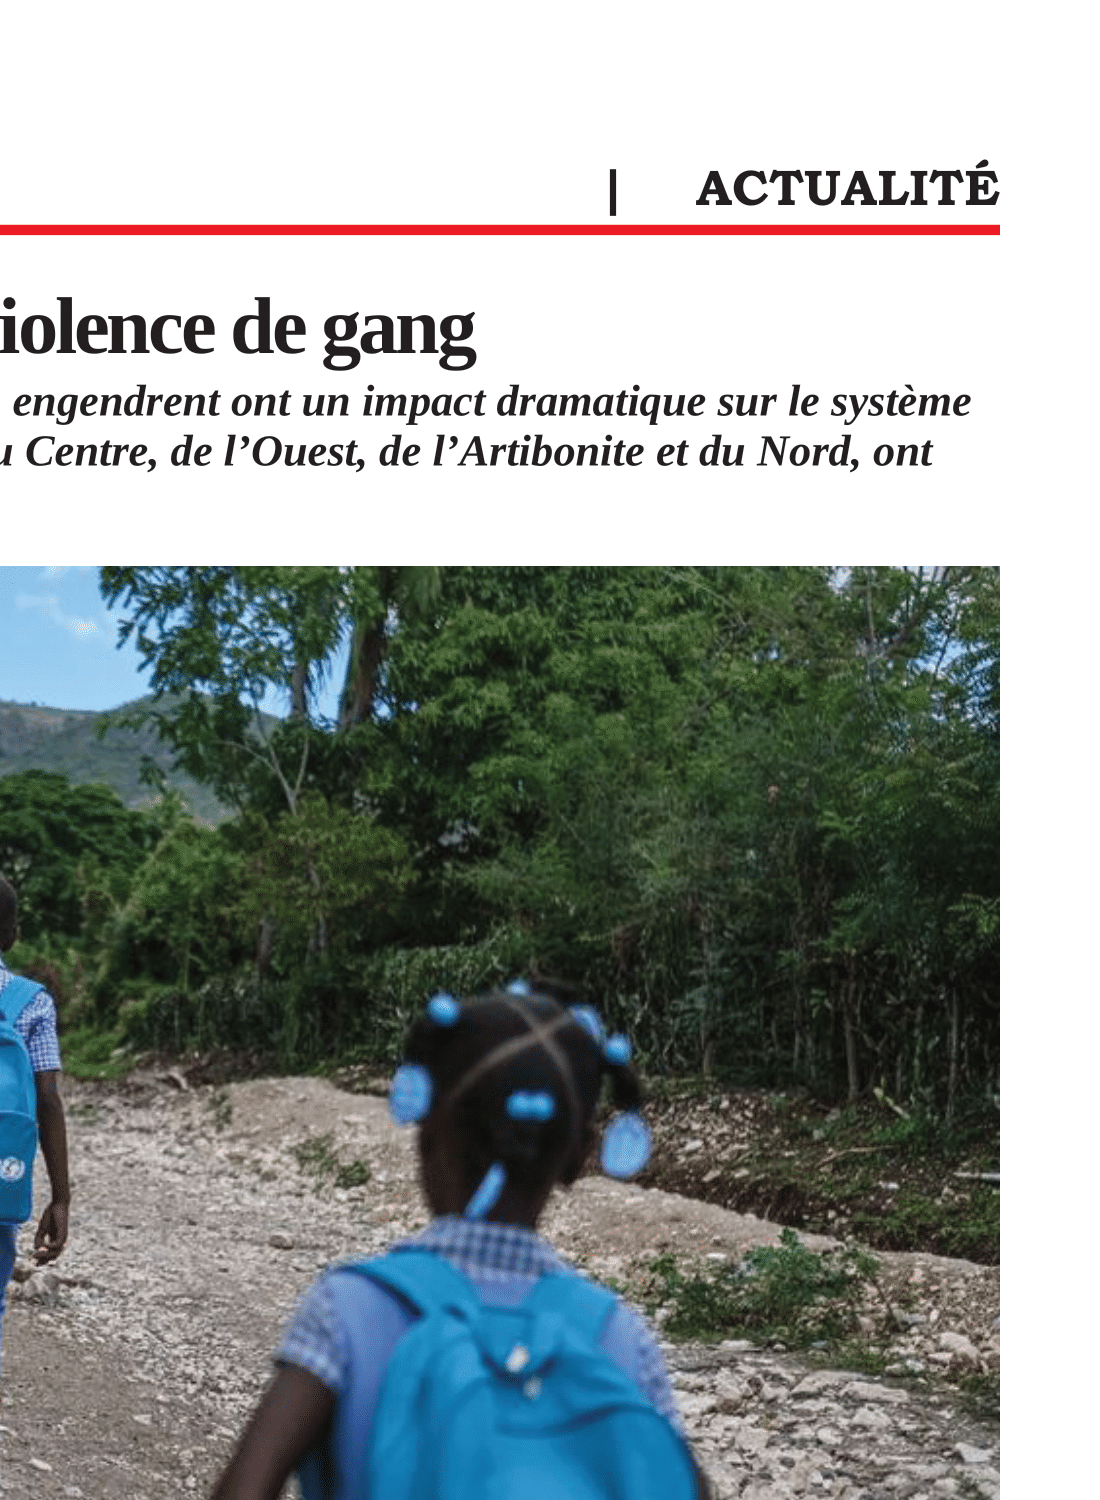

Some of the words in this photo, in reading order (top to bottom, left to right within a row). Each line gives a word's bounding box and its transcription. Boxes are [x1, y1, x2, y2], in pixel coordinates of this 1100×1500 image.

[696, 159, 1000, 206] ACTUALITÉ
[233, 297, 306, 354] de
[323, 312, 477, 371] gang
[13, 385, 221, 425] engendrent
[232, 390, 291, 416] ont
[303, 394, 349, 416] un
[363, 385, 486, 425] impact
[497, 385, 705, 425] dramatique
[717, 394, 777, 416] sur
[789, 385, 819, 416] le
[831, 384, 971, 425] système
[26, 436, 156, 472] Centre,
[171, 435, 212, 466] de
[225, 435, 365, 472] l’Ouest,
[379, 435, 420, 466] de
[434, 435, 644, 466] l’Artibonite
[657, 440, 689, 466] et
[699, 435, 744, 466] du
[757, 435, 859, 472] Nord,
[874, 440, 933, 466] ont
